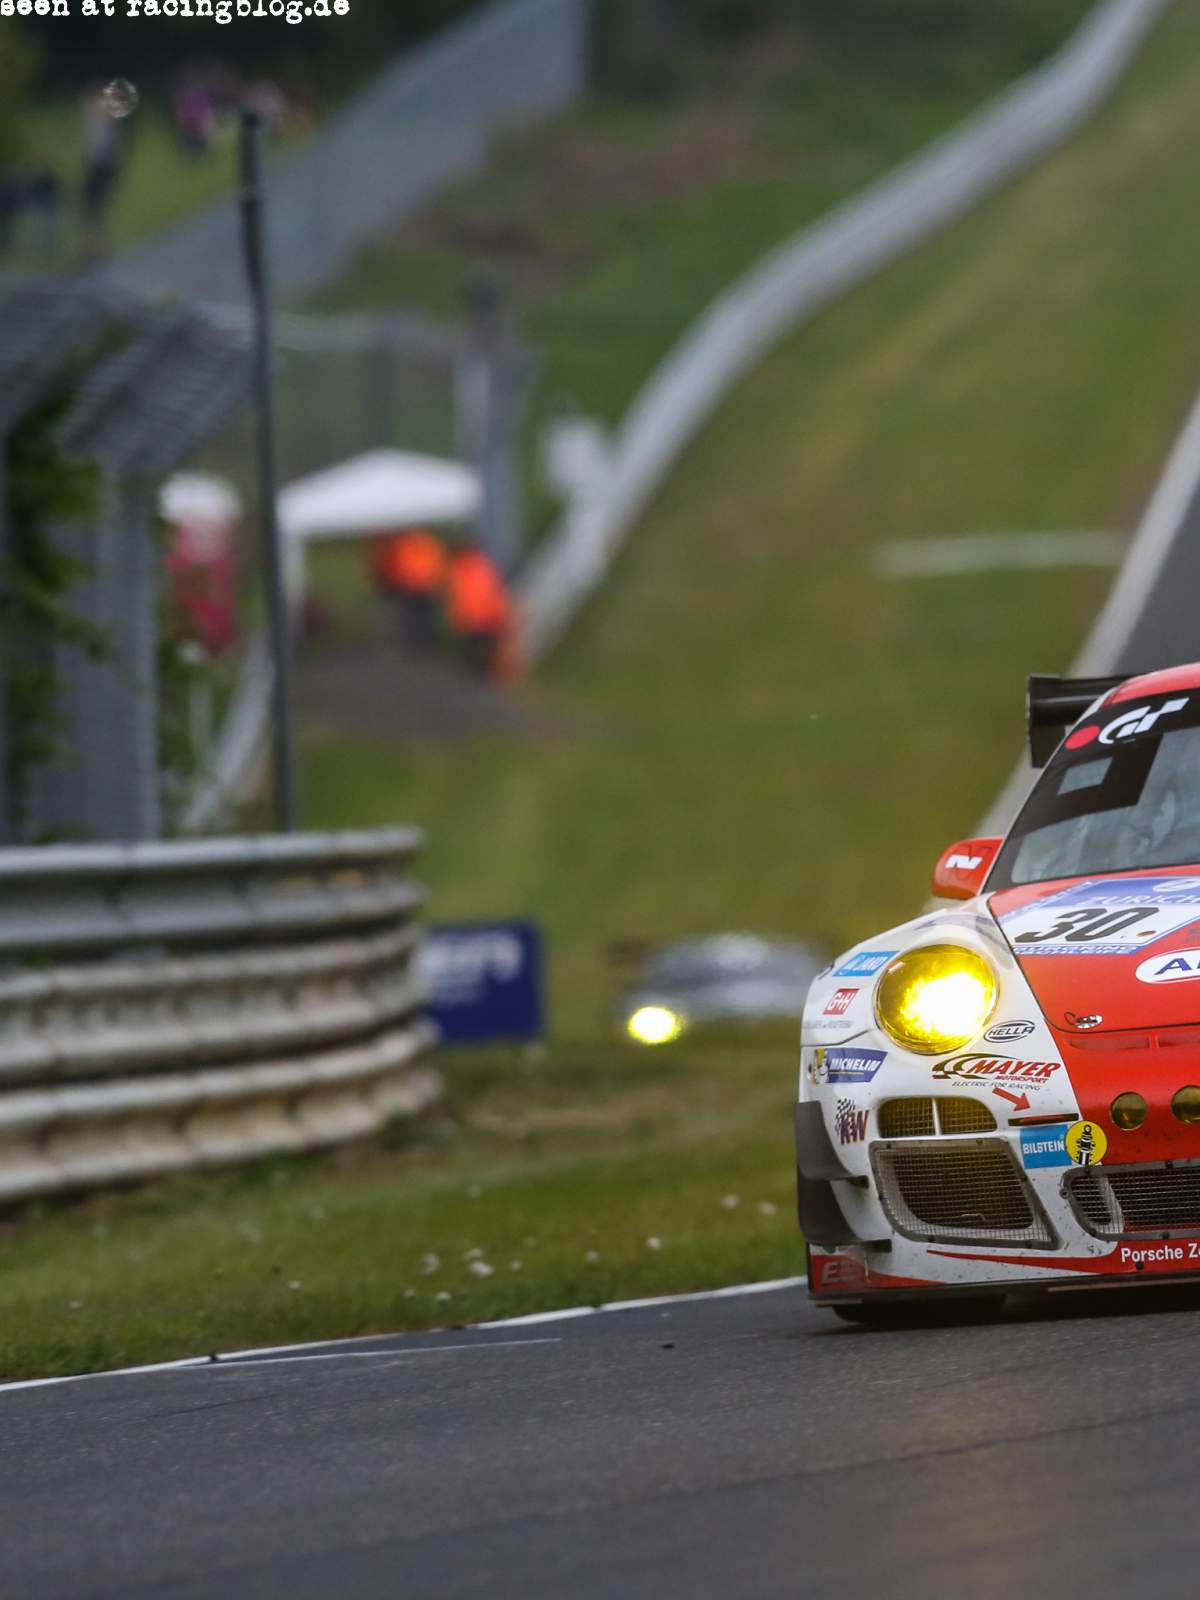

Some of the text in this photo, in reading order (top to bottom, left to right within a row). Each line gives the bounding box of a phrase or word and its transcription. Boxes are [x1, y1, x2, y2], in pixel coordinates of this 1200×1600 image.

[1013, 906, 1160, 944] 30
[987, 1026, 1036, 1036] HELLA
[829, 1058, 882, 1072] MICHELIN
[966, 1060, 1061, 1078] MAYER
[994, 1074, 1049, 1084] MOTORSPORT
[1008, 1082, 1042, 1091] RACING
[839, 1109, 870, 1145] KW
[1022, 1140, 1065, 1155] BILSTEIN
[1120, 1243, 1184, 1264] Porsche
